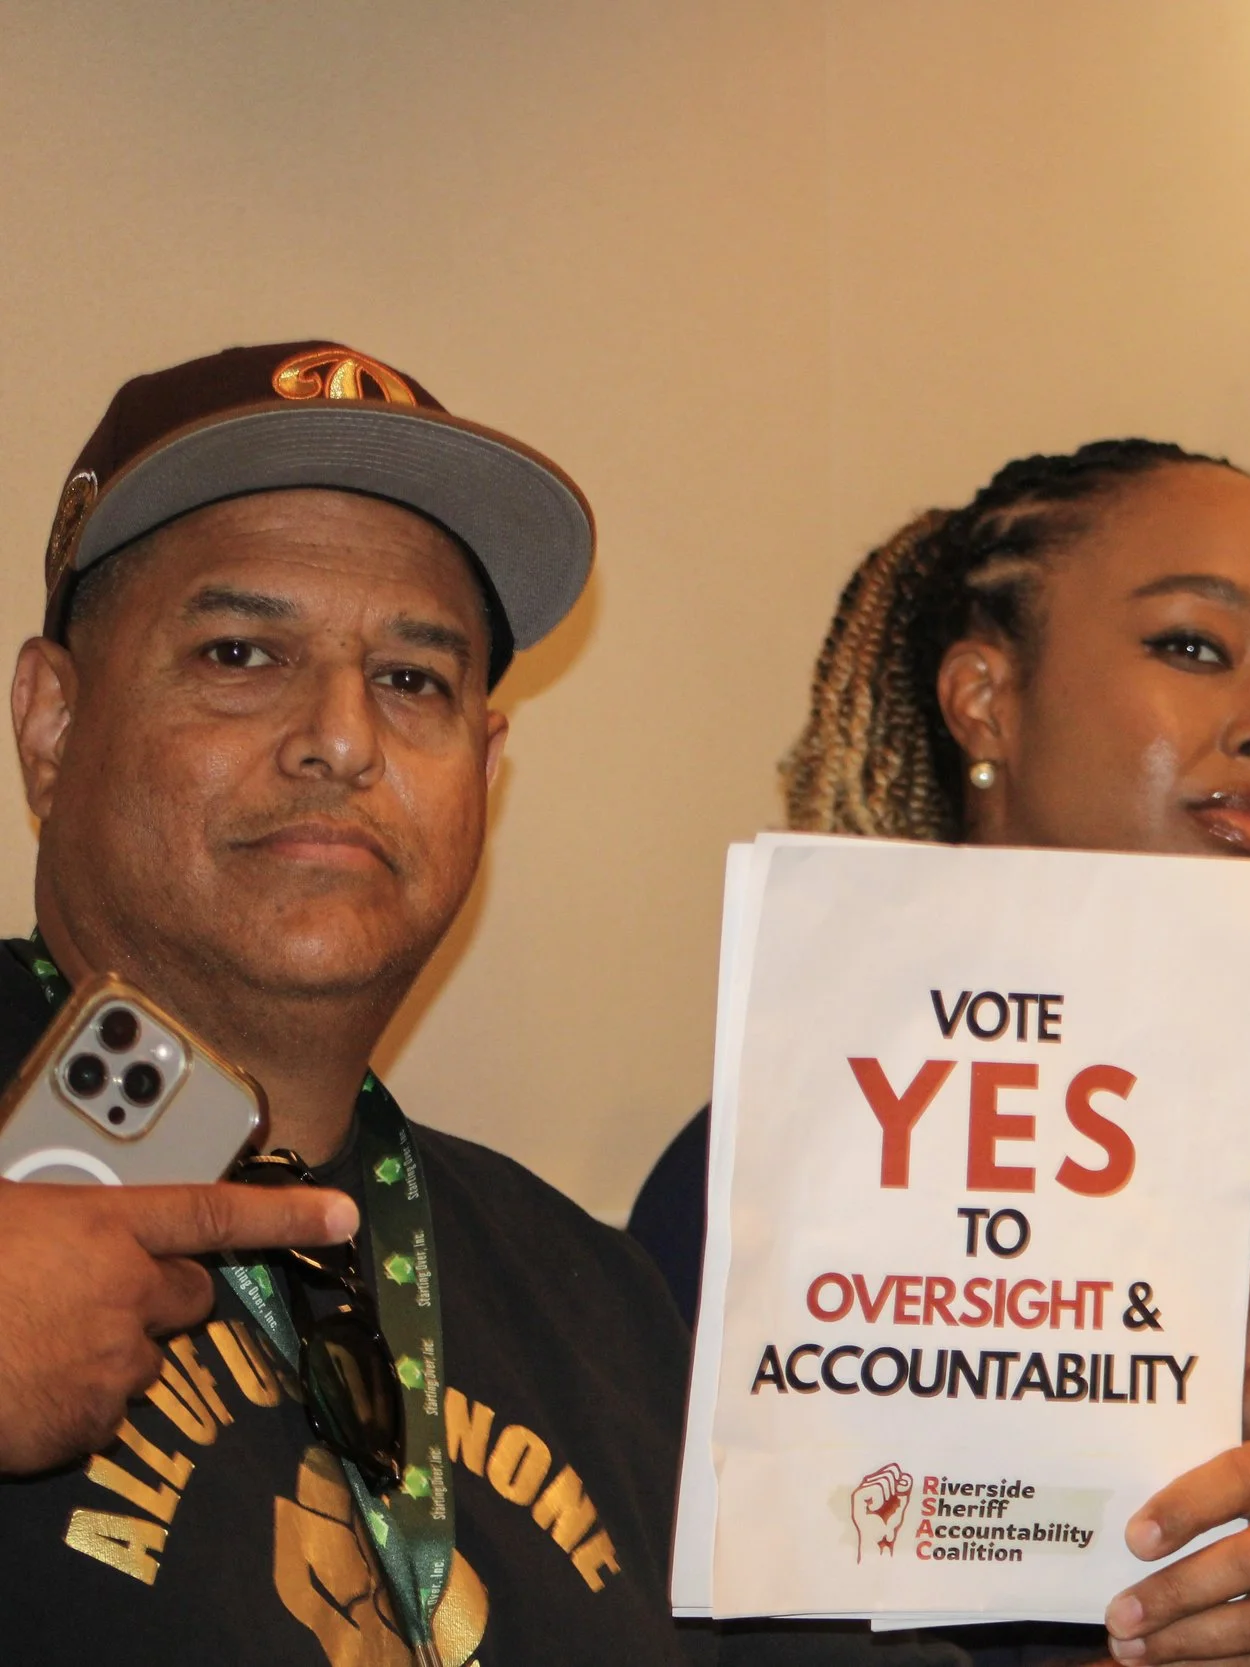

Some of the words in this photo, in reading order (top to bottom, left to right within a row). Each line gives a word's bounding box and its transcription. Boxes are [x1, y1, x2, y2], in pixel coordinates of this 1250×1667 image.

[930, 989, 1064, 1043] VOTE
[847, 1057, 1138, 1198] YES
[957, 1207, 1031, 1259] TO
[417, 1269, 431, 1306] Starting
[806, 1272, 1114, 1331] OVERSIGHT
[1122, 1281, 1164, 1332] &
[248, 1286, 266, 1314] Over,
[264, 1310, 278, 1332] Inc.
[751, 1344, 1199, 1405] ACCOUNTABILITY
[424, 1379, 439, 1416] Starting
[64, 1413, 197, 1587] ALL
[443, 1386, 622, 1593] NONE
[432, 1486, 447, 1521] Starting
[922, 1476, 1035, 1499] Riverside
[921, 1497, 1010, 1518] Sheriff
[915, 1519, 1094, 1549] Accountability
[915, 1540, 1023, 1561] Coalition
[430, 1558, 446, 1578] Inc.
